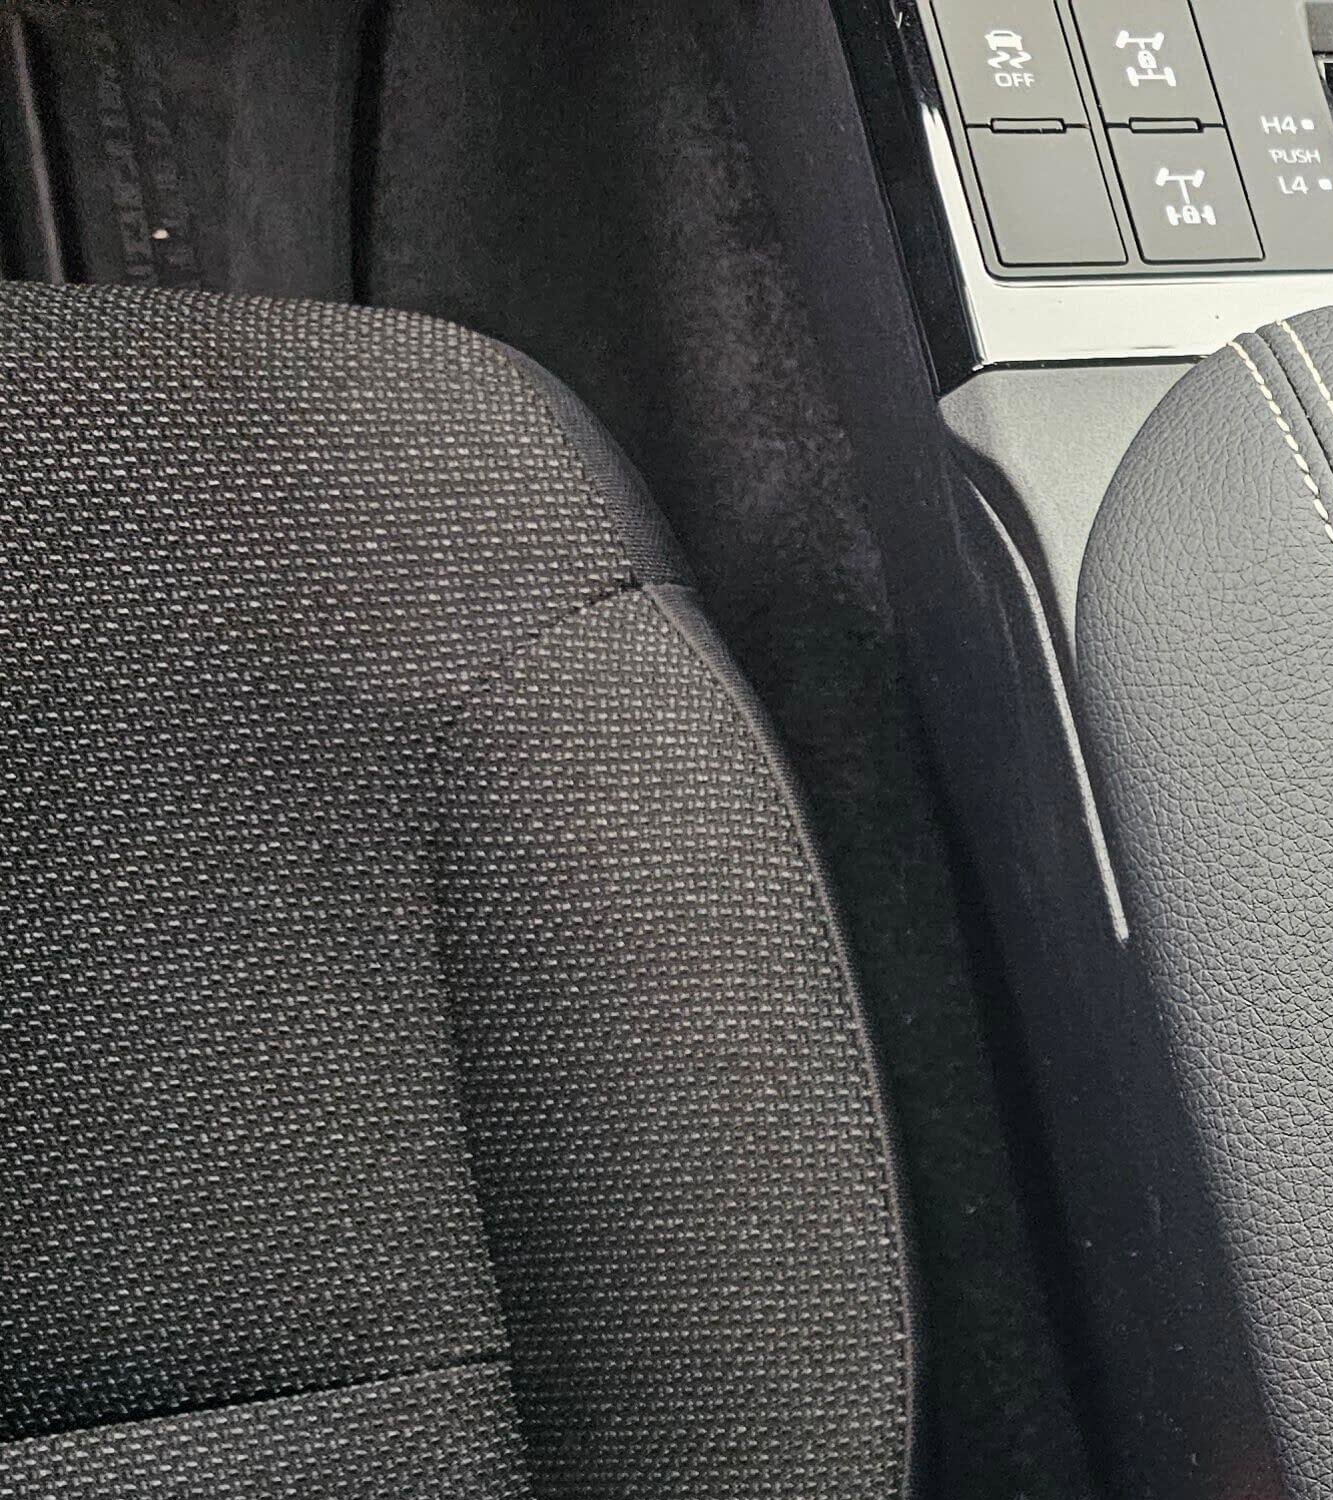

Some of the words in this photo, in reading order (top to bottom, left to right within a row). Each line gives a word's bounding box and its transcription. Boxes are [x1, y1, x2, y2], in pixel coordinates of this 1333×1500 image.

[995, 72, 1035, 87] OFF
[1260, 115, 1298, 134] H4
[1268, 149, 1321, 164] PUSH
[1278, 176, 1309, 194] L4
